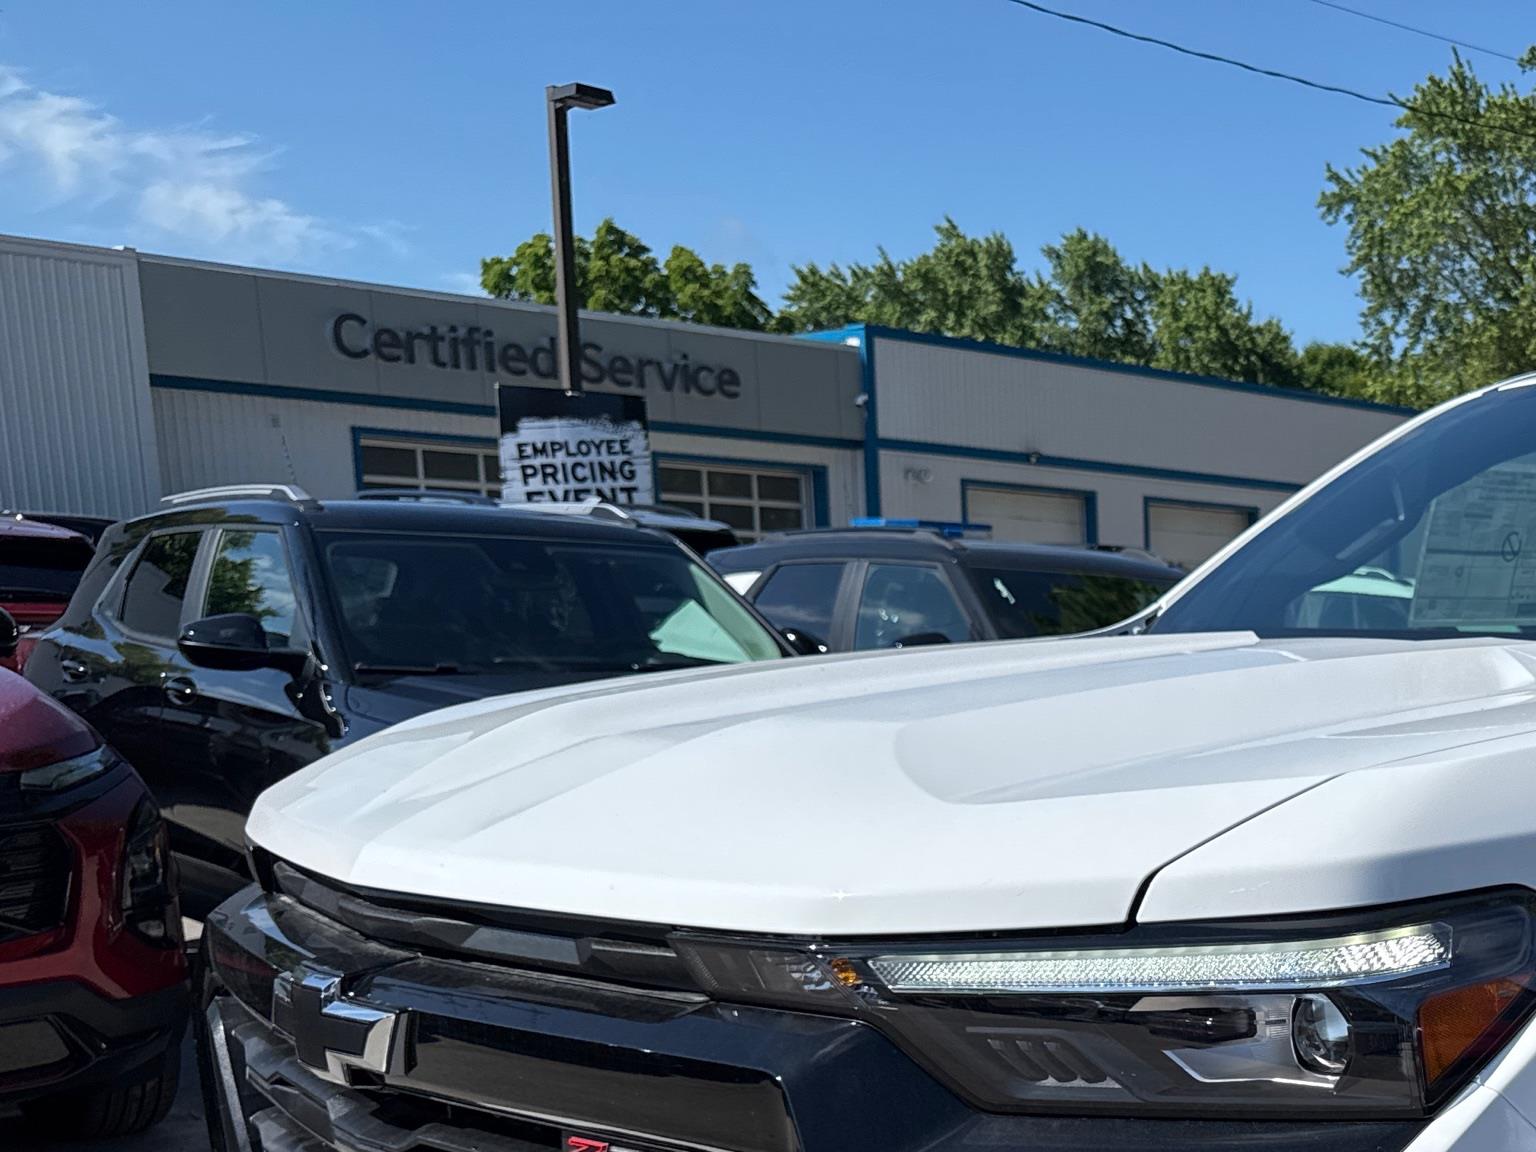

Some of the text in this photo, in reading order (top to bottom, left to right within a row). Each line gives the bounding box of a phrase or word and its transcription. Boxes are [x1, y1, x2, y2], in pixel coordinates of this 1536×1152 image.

[332, 312, 741, 399] Certified Service
[516, 438, 634, 461] EMPLOYEE
[520, 459, 637, 488] PRICING
